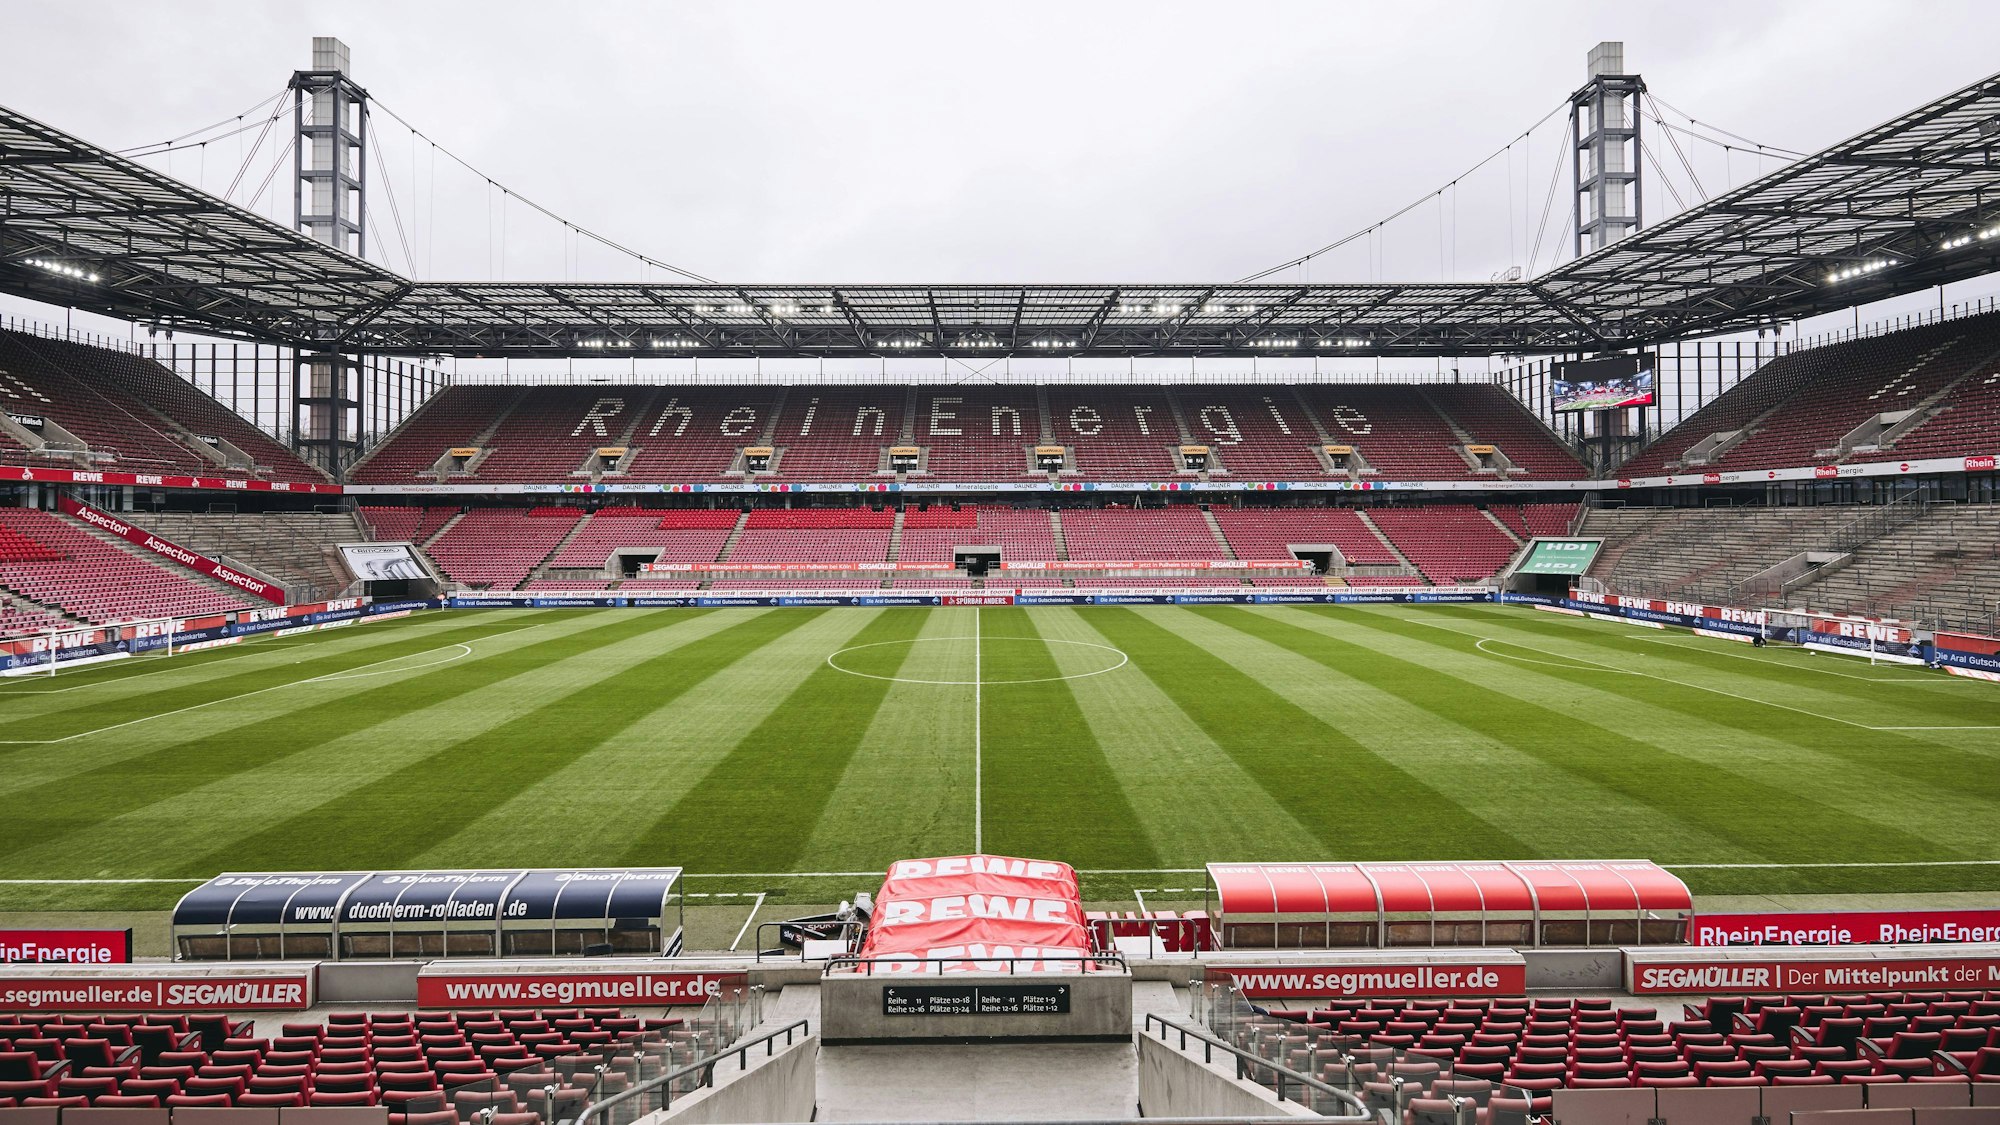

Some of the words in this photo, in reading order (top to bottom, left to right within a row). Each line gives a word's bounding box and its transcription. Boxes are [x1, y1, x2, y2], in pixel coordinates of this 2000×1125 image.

[73, 471, 103, 482] REWE
[136, 475, 162, 484] REWE
[226, 480, 247, 488] REWE
[271, 482, 290, 490] REWE
[1546, 543, 1588, 551] HDI
[1577, 591, 1605, 603] REWE
[327, 599, 357, 612] REWE
[1619, 597, 1650, 610] REWE
[1666, 602, 1703, 617] REWE
[1648, 612, 1682, 623] Gutscheinkarten.
[136, 620, 185, 638] REWE
[257, 620, 292, 630] Gutscheinkarten.
[1840, 622, 1900, 643] REWE
[1819, 635, 1831, 643] Aral
[1832, 637, 1887, 652] Gutscheinkaten.
[7, 659, 20, 667] Die
[23, 656, 38, 664] Aral
[1936, 652, 1948, 660] Die
[1950, 654, 1966, 663] Aral
[891, 857, 1059, 880] REWE
[883, 893, 1067, 925] REWE
[783, 930, 794, 940] sky
[1233, 967, 1498, 994] www.segmueller.de
[1641, 966, 1769, 988] SEGMÜLLER
[1789, 969, 1818, 985] Der
[1825, 966, 1949, 987] Mittelpunkt
[1954, 965, 1982, 981] der
[166, 982, 302, 1005] SEGMÜLLER
[446, 975, 720, 1003] www.segmueller.de
[930, 996, 951, 1004] Plätze
[982, 996, 1001, 1004] Reihe
[1023, 995, 1044, 1003] Plätze
[1045, 996, 1056, 1005] 1-9
[887, 1005, 907, 1013] Reihe
[908, 1005, 925, 1013] 12-16
[930, 1005, 951, 1013] Plätze
[952, 1005, 970, 1014] 13-24
[1023, 1004, 1044, 1012] Plätze
